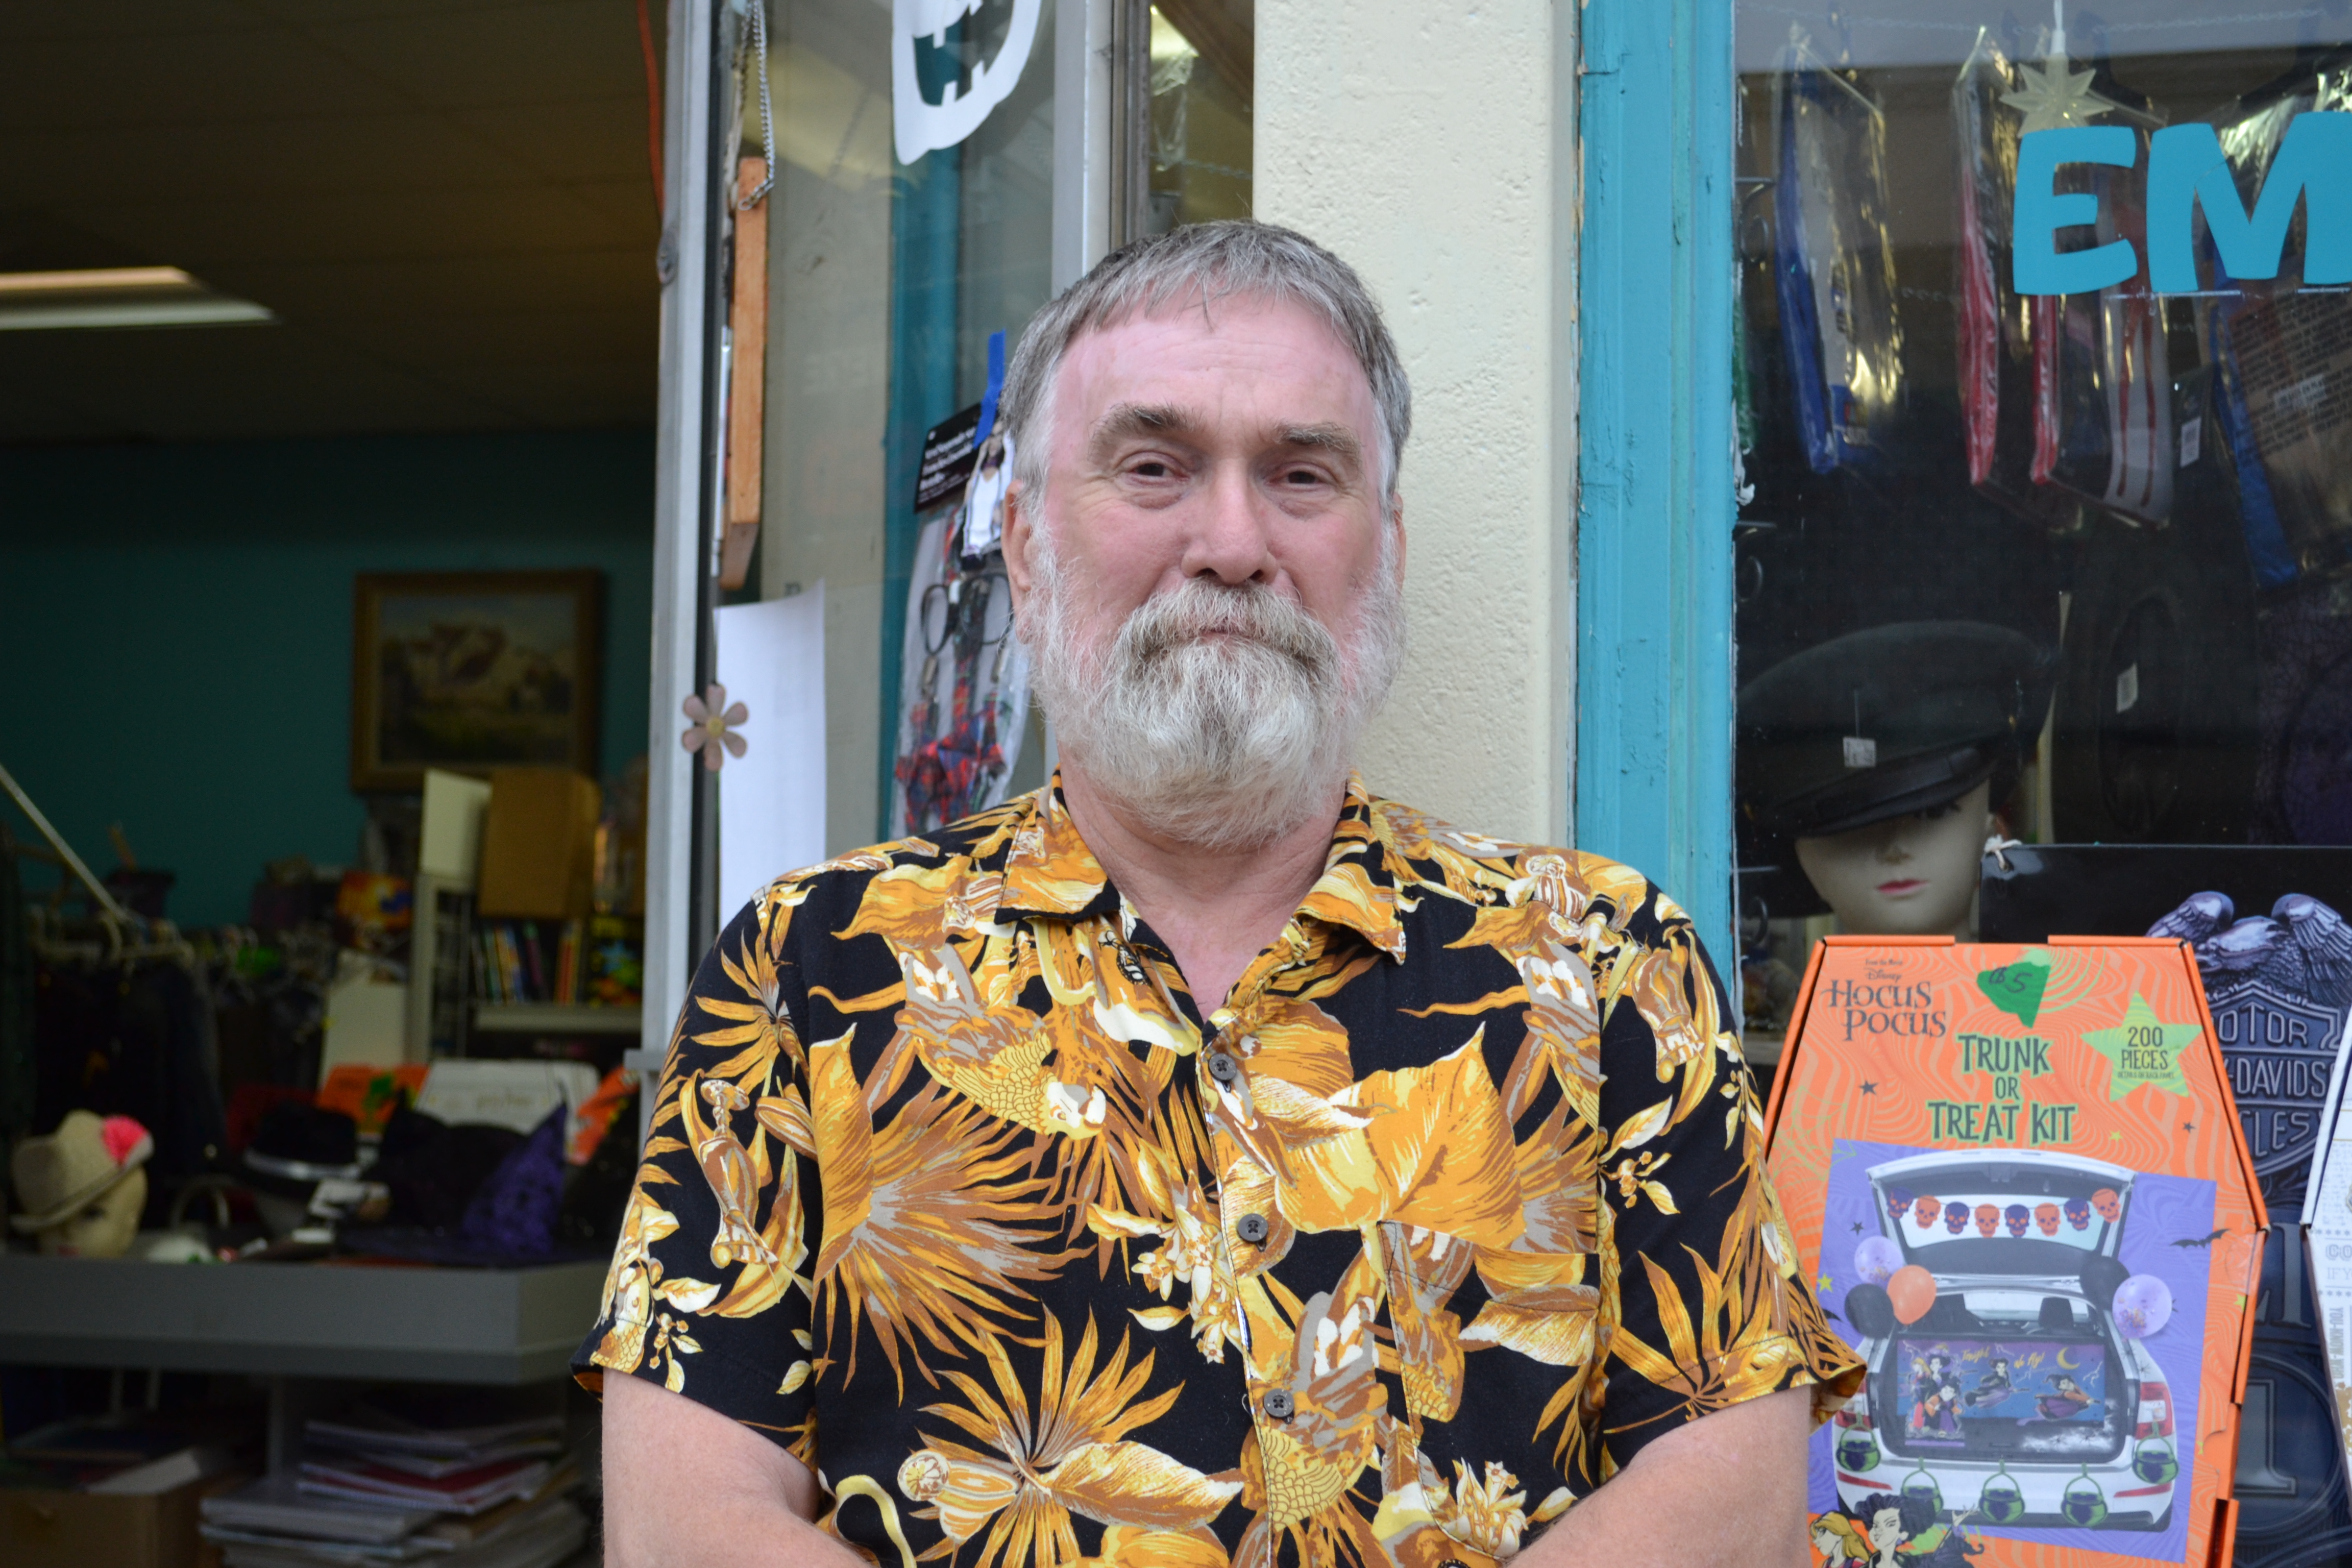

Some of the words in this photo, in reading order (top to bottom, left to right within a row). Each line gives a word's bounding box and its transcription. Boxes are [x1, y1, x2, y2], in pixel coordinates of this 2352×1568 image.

[1864, 968, 1902, 984] Disney
[1821, 979, 1931, 1009] HOCUS
[1841, 1009, 1946, 1041] POCUS
[2127, 1026, 2163, 1047] 200
[2212, 1001, 2309, 1046] OTOR
[1957, 1034, 2051, 1076] TRUNK
[2121, 1049, 2169, 1070] PIECES
[1995, 1076, 2020, 1100] OR
[2224, 1058, 2335, 1097] -DAVIDS
[1927, 1101, 2020, 1143] TREAT
[2031, 1102, 2076, 1144] KIT
